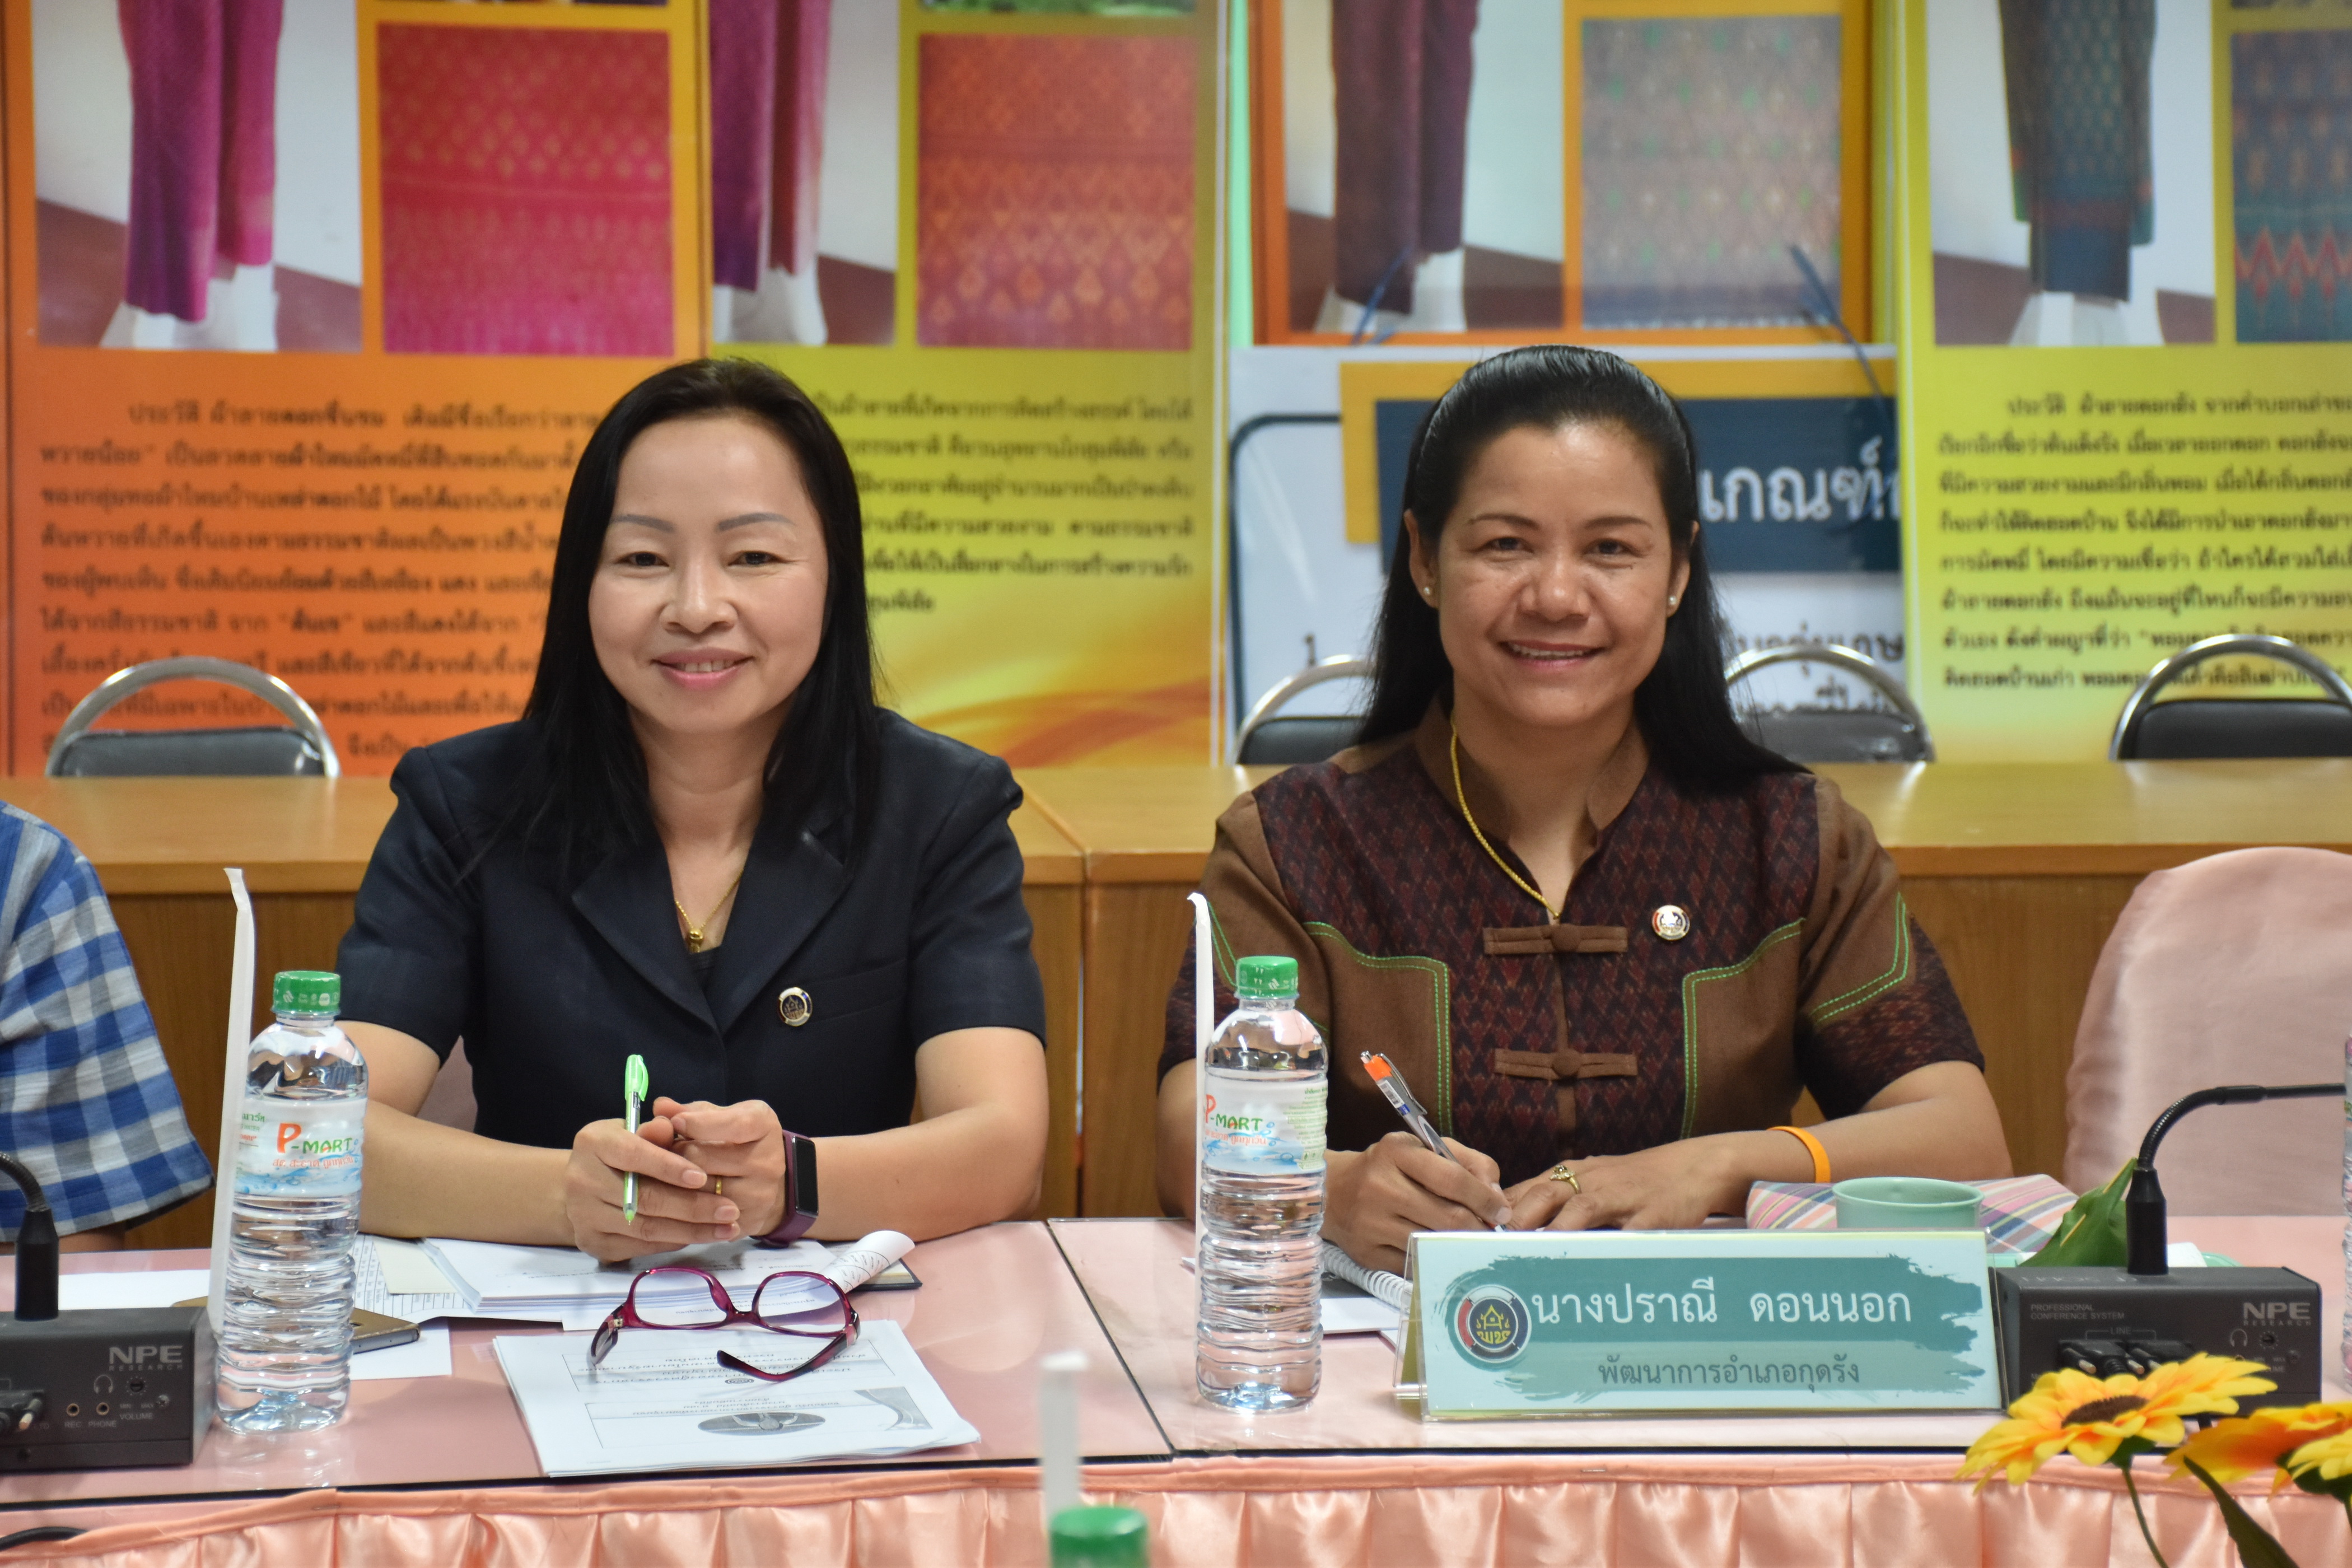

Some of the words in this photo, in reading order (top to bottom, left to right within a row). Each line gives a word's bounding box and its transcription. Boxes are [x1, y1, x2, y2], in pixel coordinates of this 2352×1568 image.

[1699, 435, 1900, 522] เกณฑ์
[277, 1122, 352, 1154] P-MART
[1532, 1276, 1718, 1323] นางปราณี
[1750, 1293, 1911, 1323] ดอนนอก
[2031, 1303, 2094, 1312] PROFESSIONAL
[2031, 1312, 2088, 1320] CONFERENCE
[2090, 1311, 2125, 1319] SYSTEM
[2243, 1301, 2311, 1320] NPE
[109, 1345, 183, 1365] NPE
[109, 1364, 183, 1372] RESEARCH
[1598, 1353, 1860, 1393] พัฒนาการอำเภอกุดรัง
[64, 1421, 82, 1429] REC
[88, 1420, 117, 1429] PHONE
[119, 1412, 154, 1421] VOLUME
